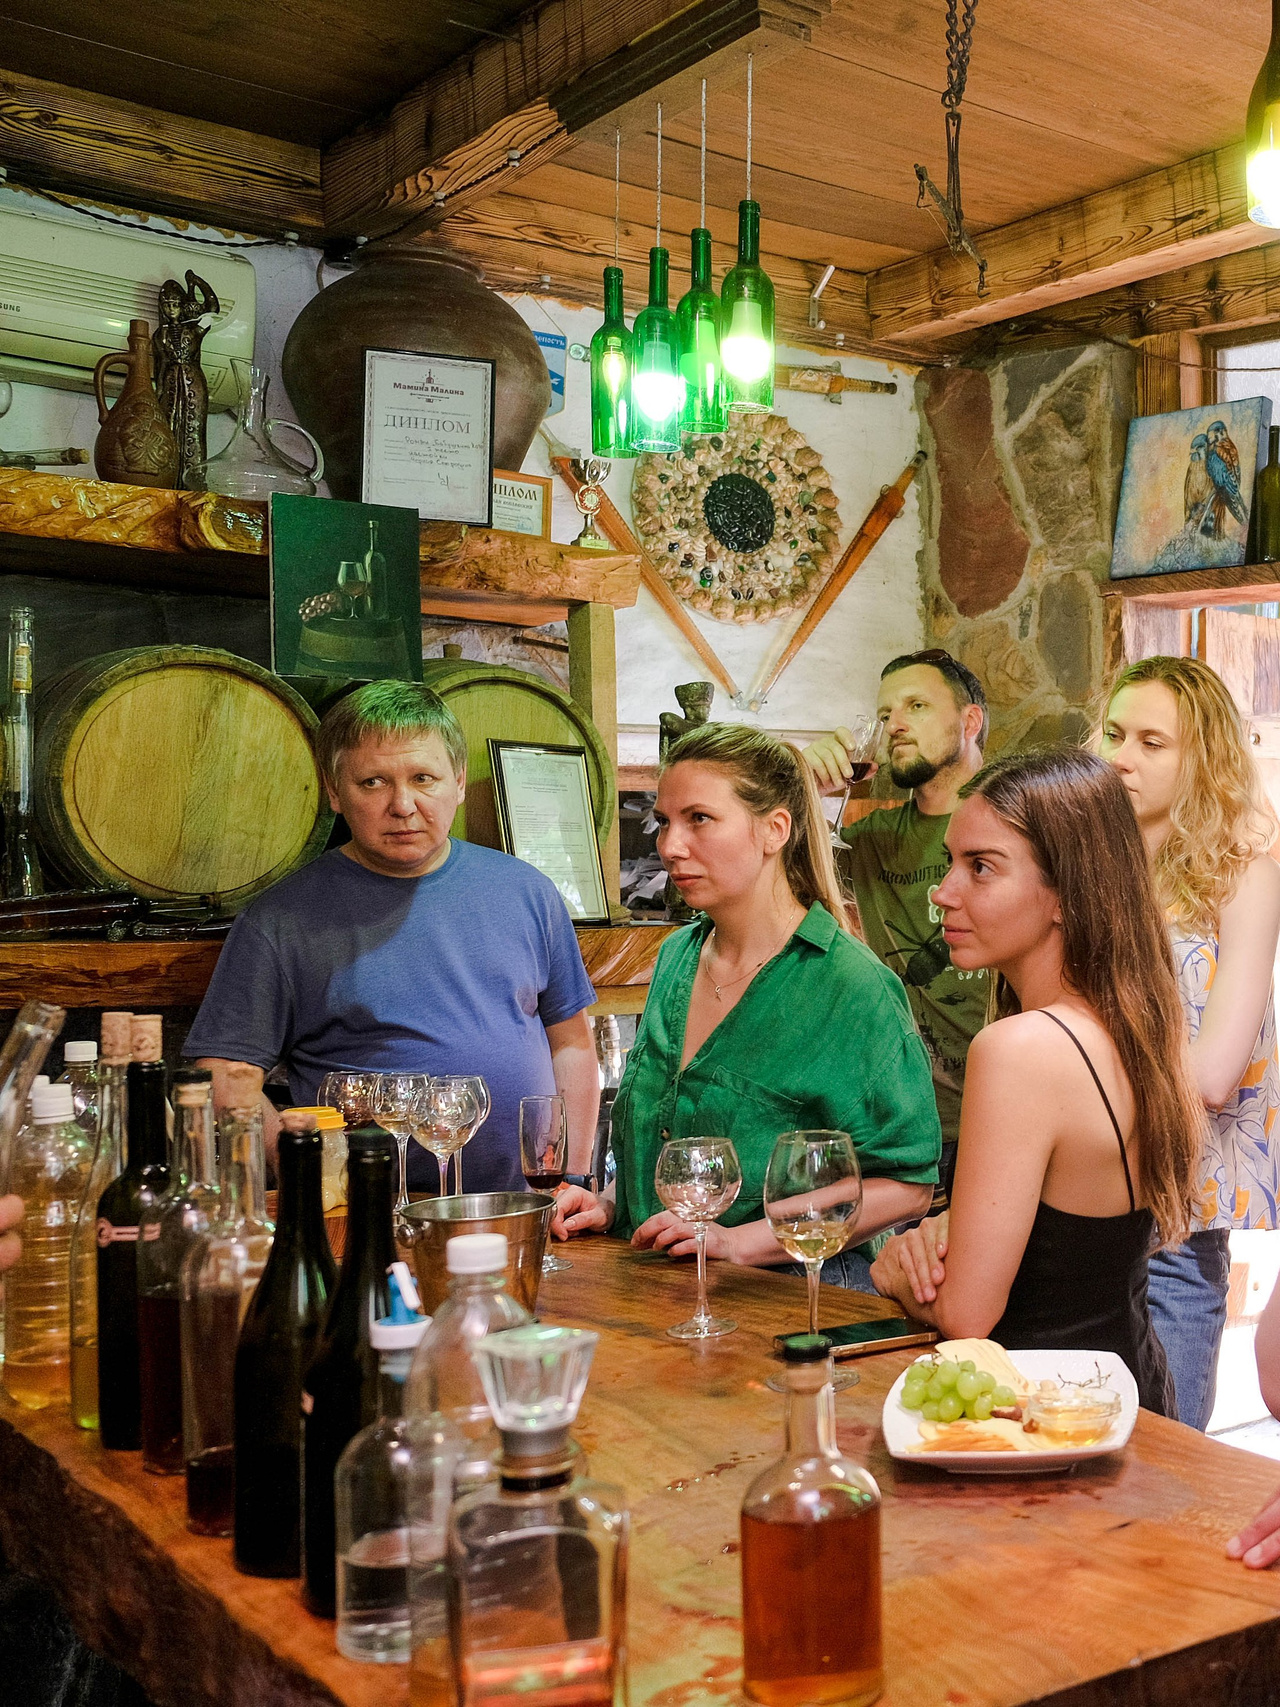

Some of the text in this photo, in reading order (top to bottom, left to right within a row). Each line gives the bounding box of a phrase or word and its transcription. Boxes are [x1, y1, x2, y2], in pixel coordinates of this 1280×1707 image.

[393, 382, 429, 392] Мамина
[430, 386, 465, 396] Малина
[384, 414, 471, 434] ДИПЛОМ
[494, 484, 537, 501] ПЛОМ
